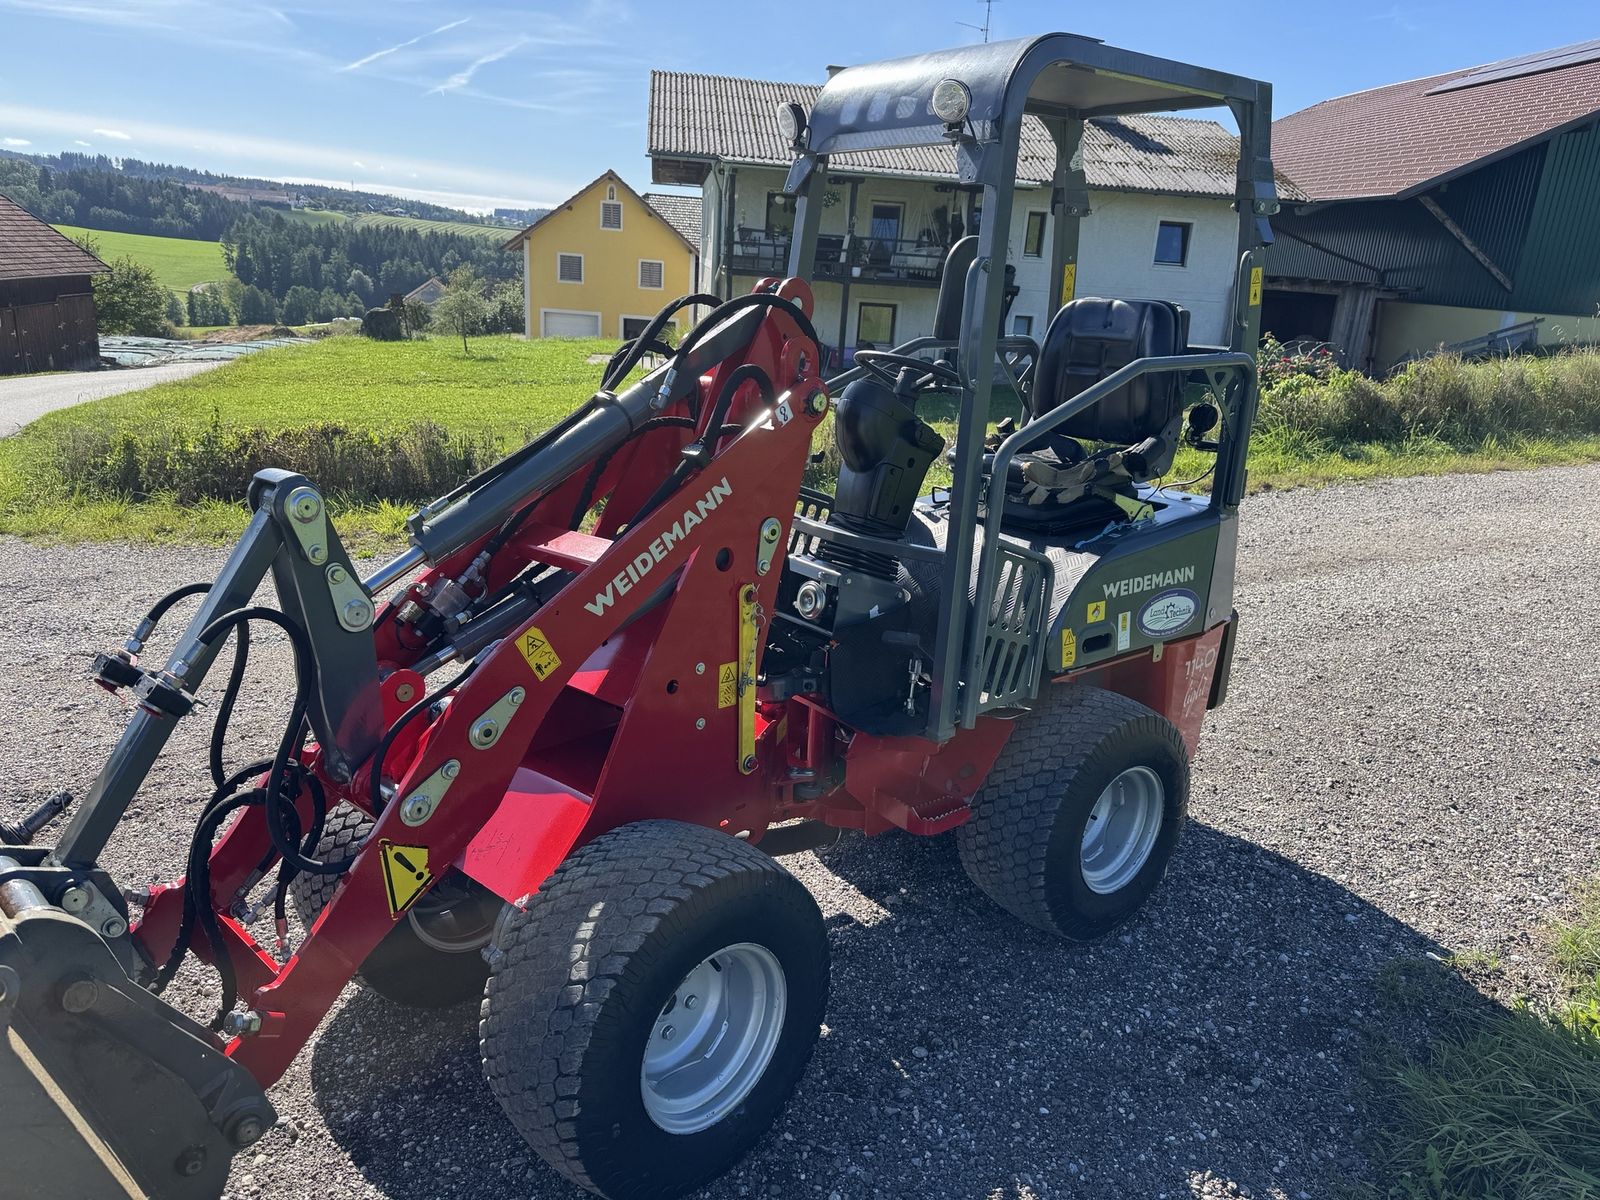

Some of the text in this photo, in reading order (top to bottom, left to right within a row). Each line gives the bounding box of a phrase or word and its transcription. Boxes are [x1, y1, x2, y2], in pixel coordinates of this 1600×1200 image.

[584, 477, 733, 617] WEIDEMANN
[1103, 566, 1195, 599] WEIDEMANN
[1185, 647, 1216, 677] 1140
